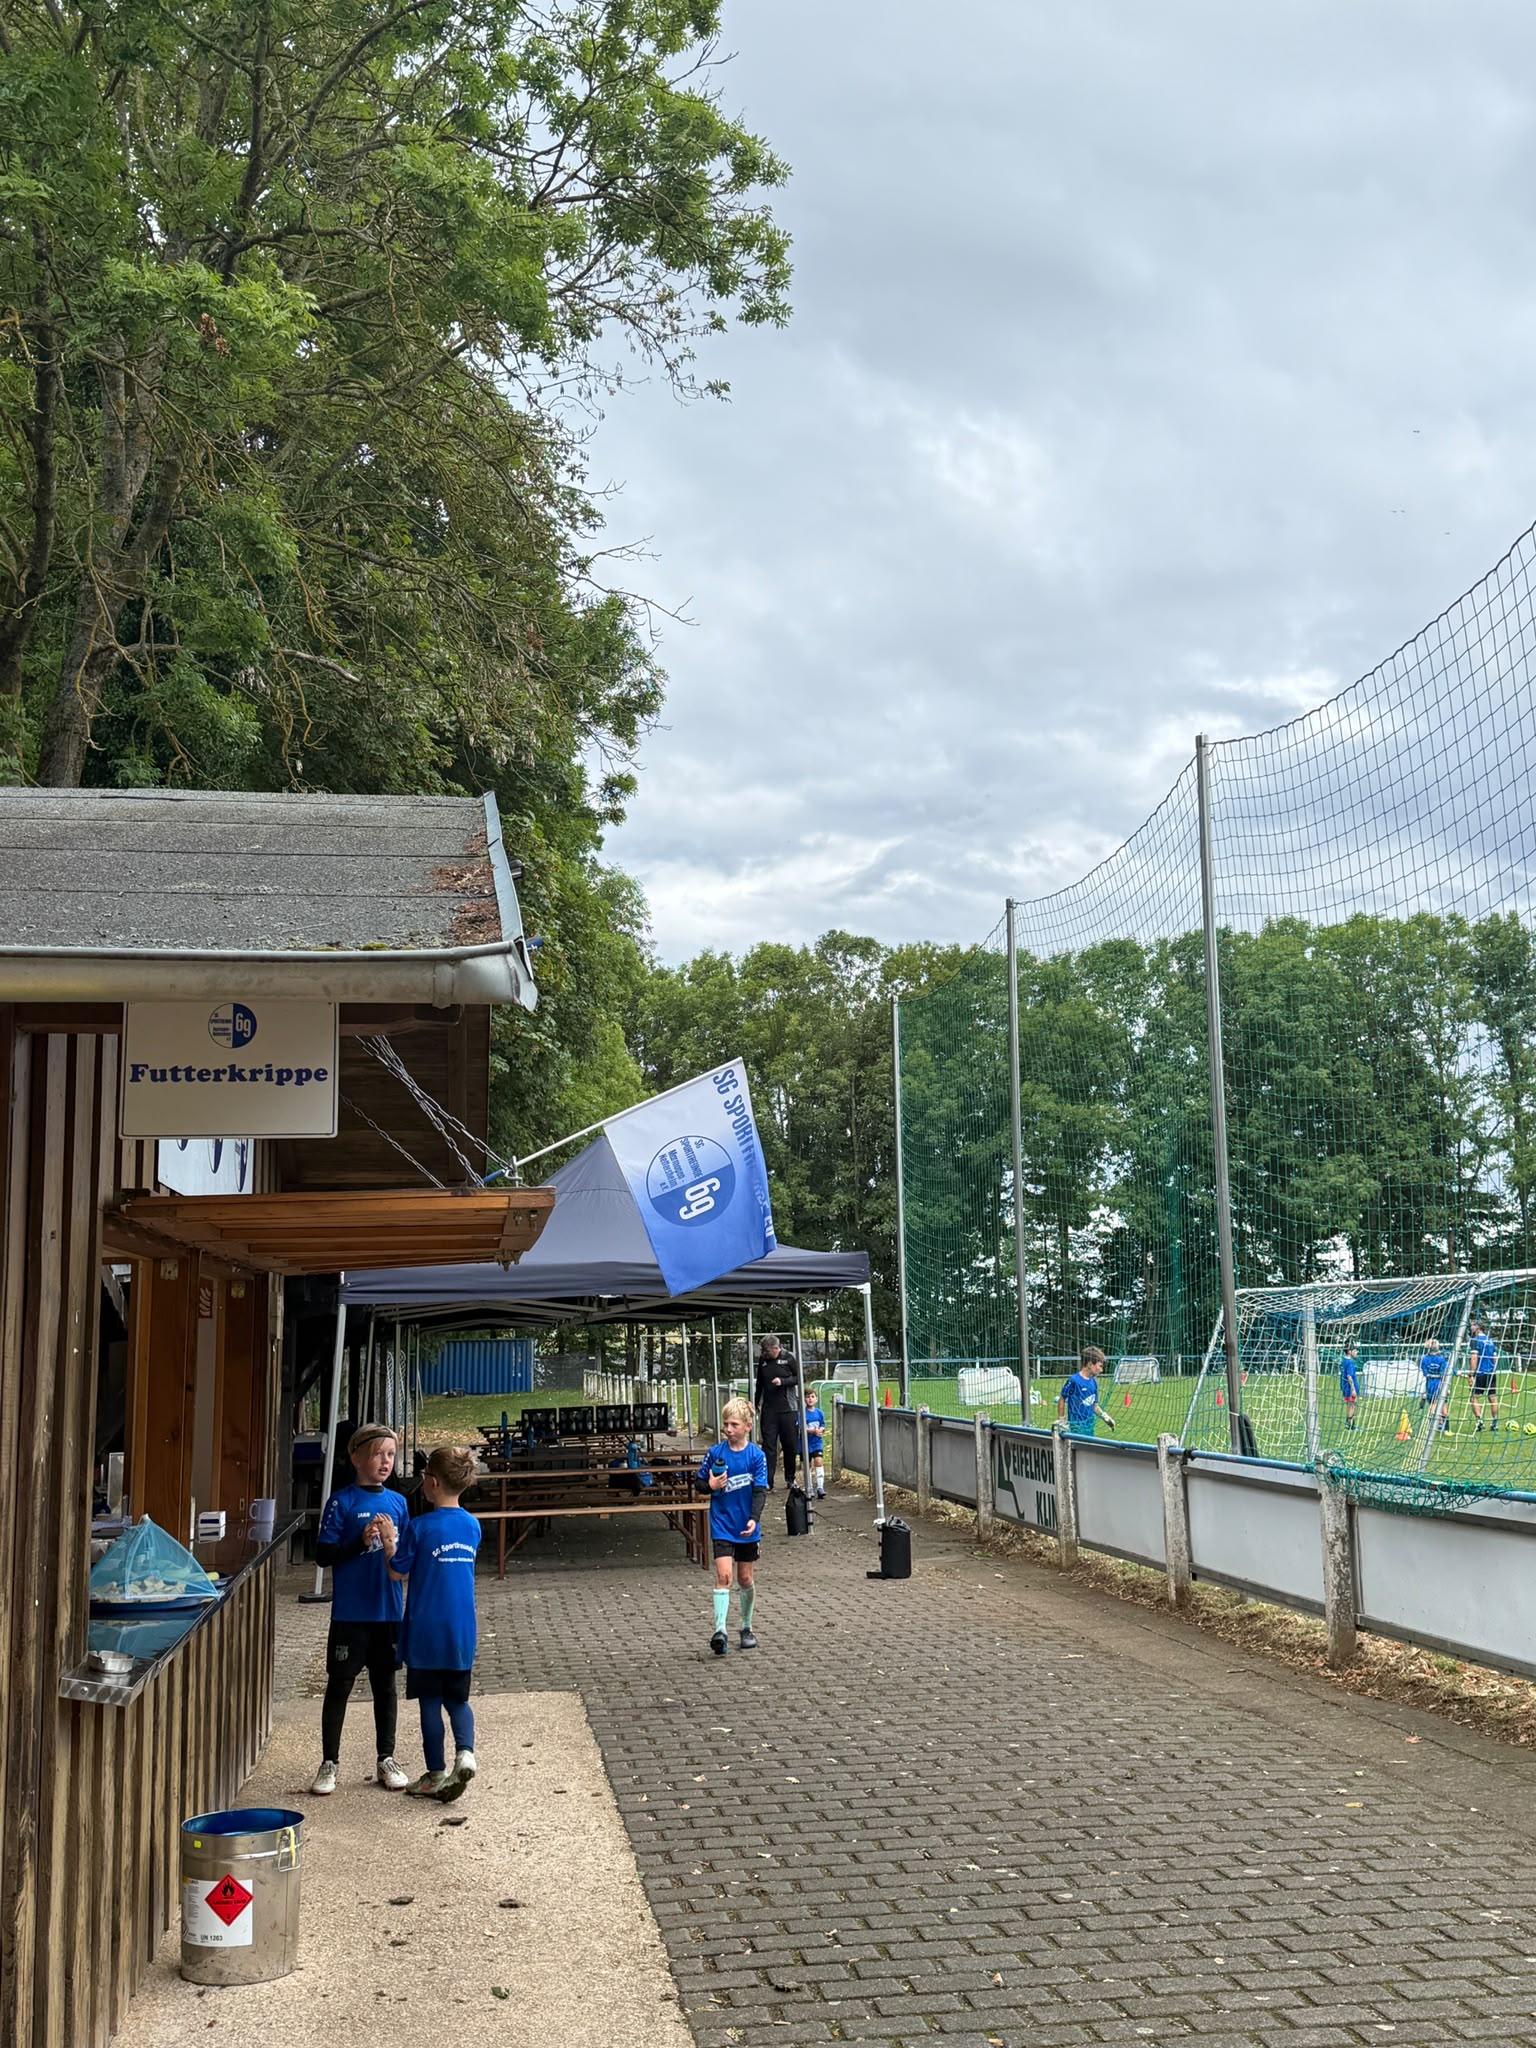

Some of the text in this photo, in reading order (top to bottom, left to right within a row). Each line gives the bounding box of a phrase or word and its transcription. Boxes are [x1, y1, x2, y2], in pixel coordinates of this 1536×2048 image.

[236, 1013, 251, 1038] 69
[130, 1064, 328, 1086] Futterkrippe
[713, 1069, 738, 1095] SG
[679, 1177, 721, 1221] 69
